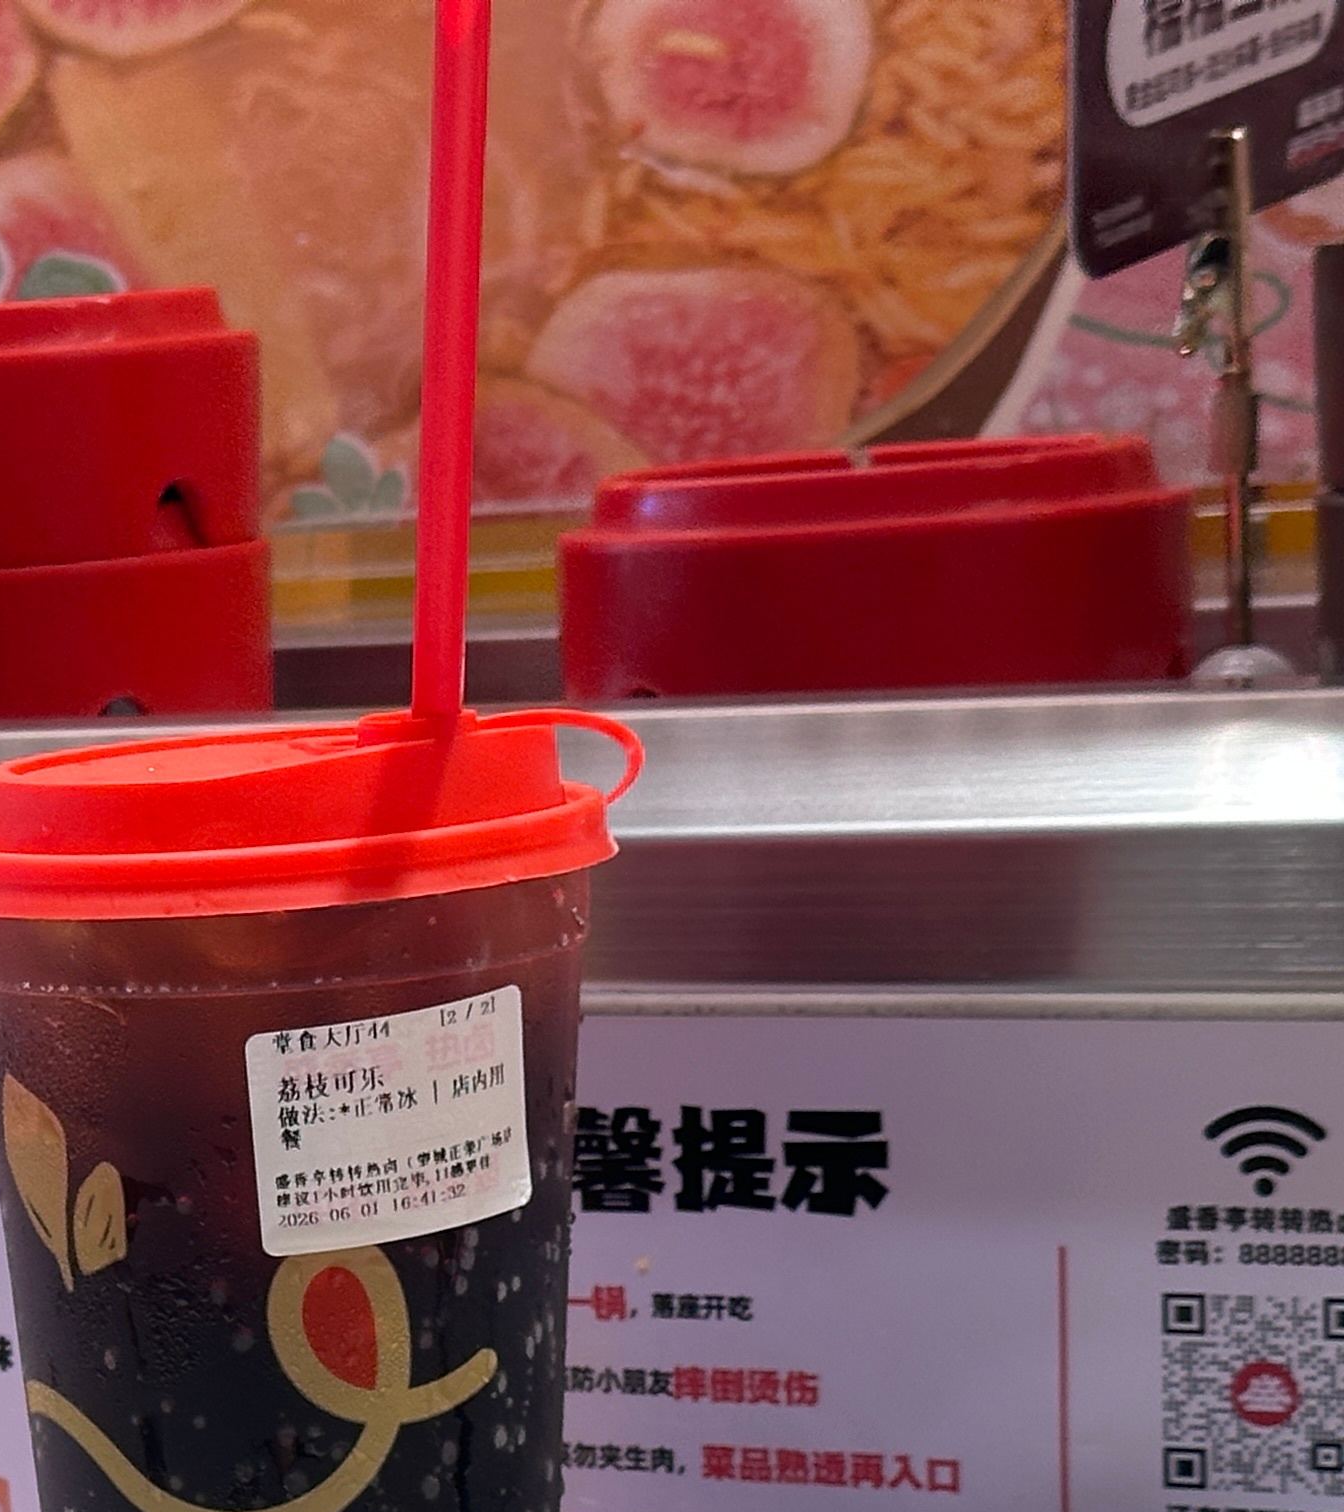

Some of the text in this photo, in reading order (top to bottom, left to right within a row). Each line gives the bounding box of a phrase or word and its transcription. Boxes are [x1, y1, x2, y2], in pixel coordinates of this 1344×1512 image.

[278, 1065, 385, 1104] 荔枝可乐
[572, 1105, 890, 1217] 馨提示
